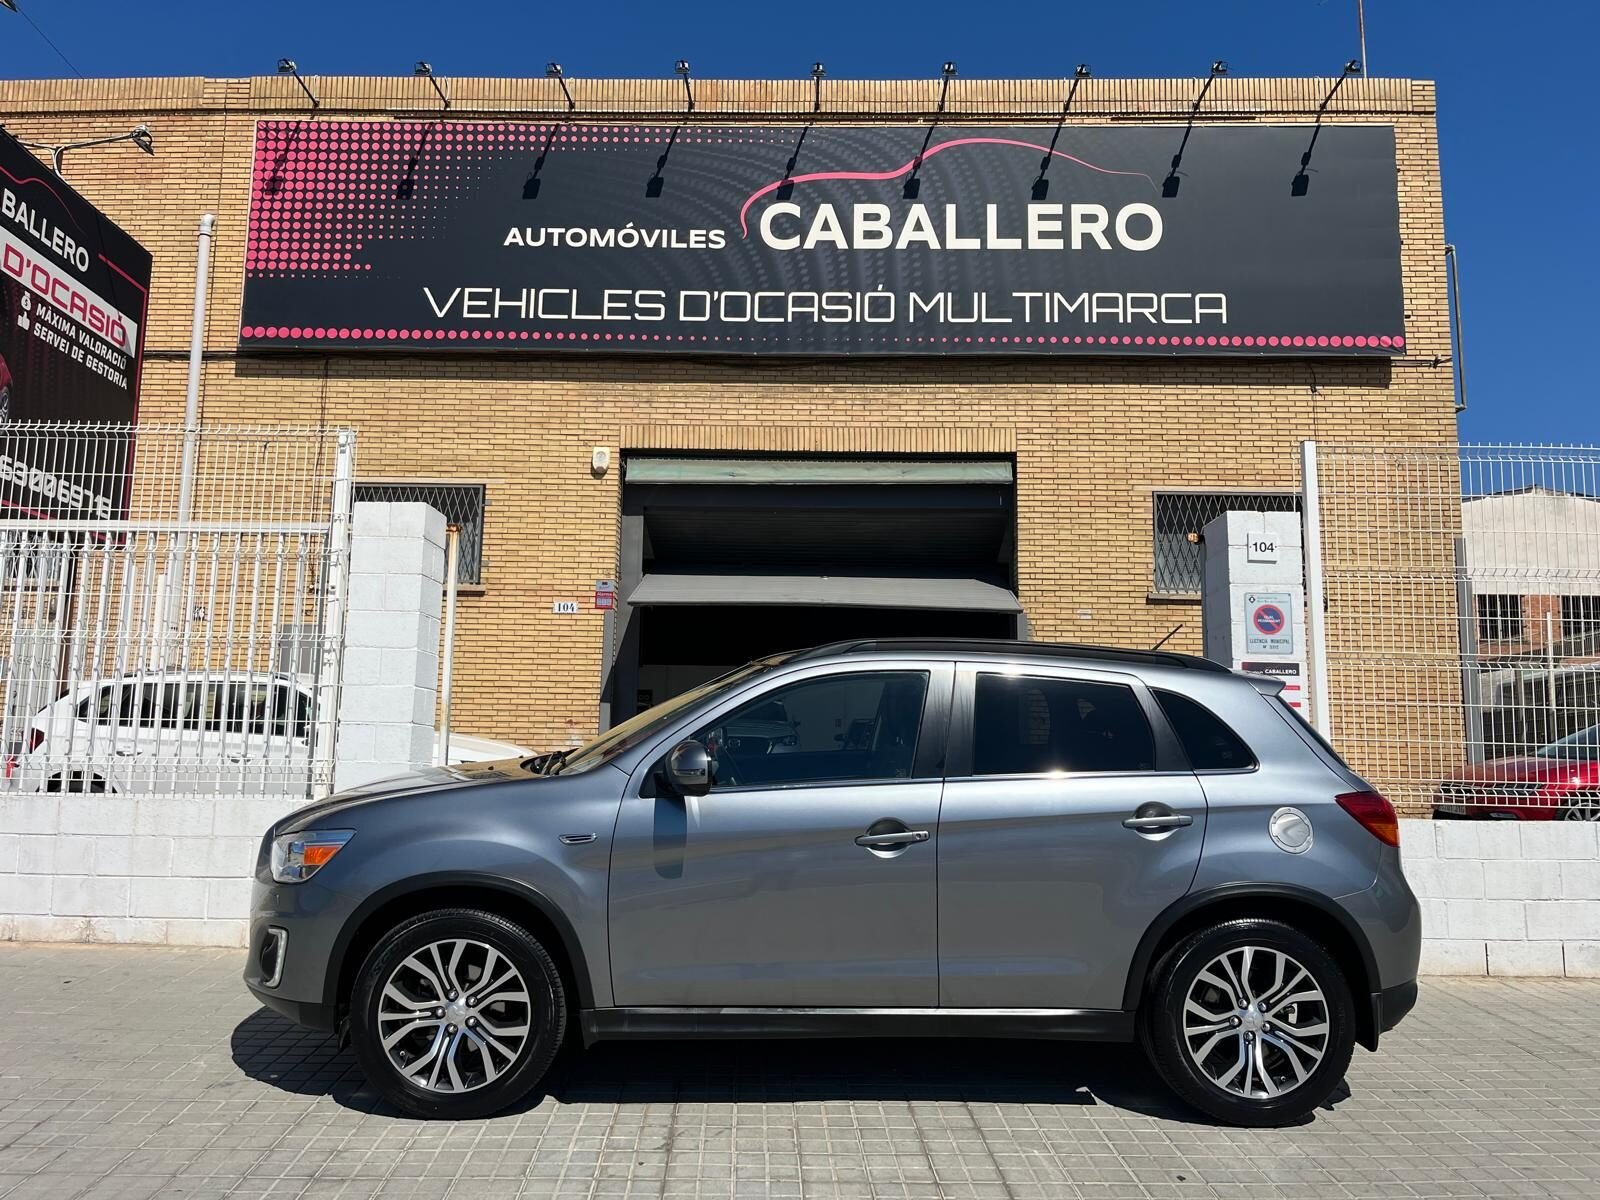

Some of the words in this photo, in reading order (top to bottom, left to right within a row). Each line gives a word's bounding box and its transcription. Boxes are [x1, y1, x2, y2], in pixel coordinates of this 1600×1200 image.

[1, 187, 90, 273] BALLERO
[503, 222, 726, 250] AUTOMÓVILES
[760, 202, 1164, 251] CABALLERO
[3, 242, 127, 348] D'OCASIÓ
[423, 286, 666, 321] VEHICLES
[678, 284, 895, 323] D'OCASIÓ
[909, 291, 1227, 324] MULTIMARCA
[33, 322, 69, 354] SERVEI
[71, 345, 85, 363] DE
[85, 354, 128, 390] GESTORIA
[36, 303, 76, 339] MÀXIMA
[79, 329, 127, 370] VALORACIÓ
[1252, 541, 1275, 553] 104
[558, 602, 575, 612] 104
